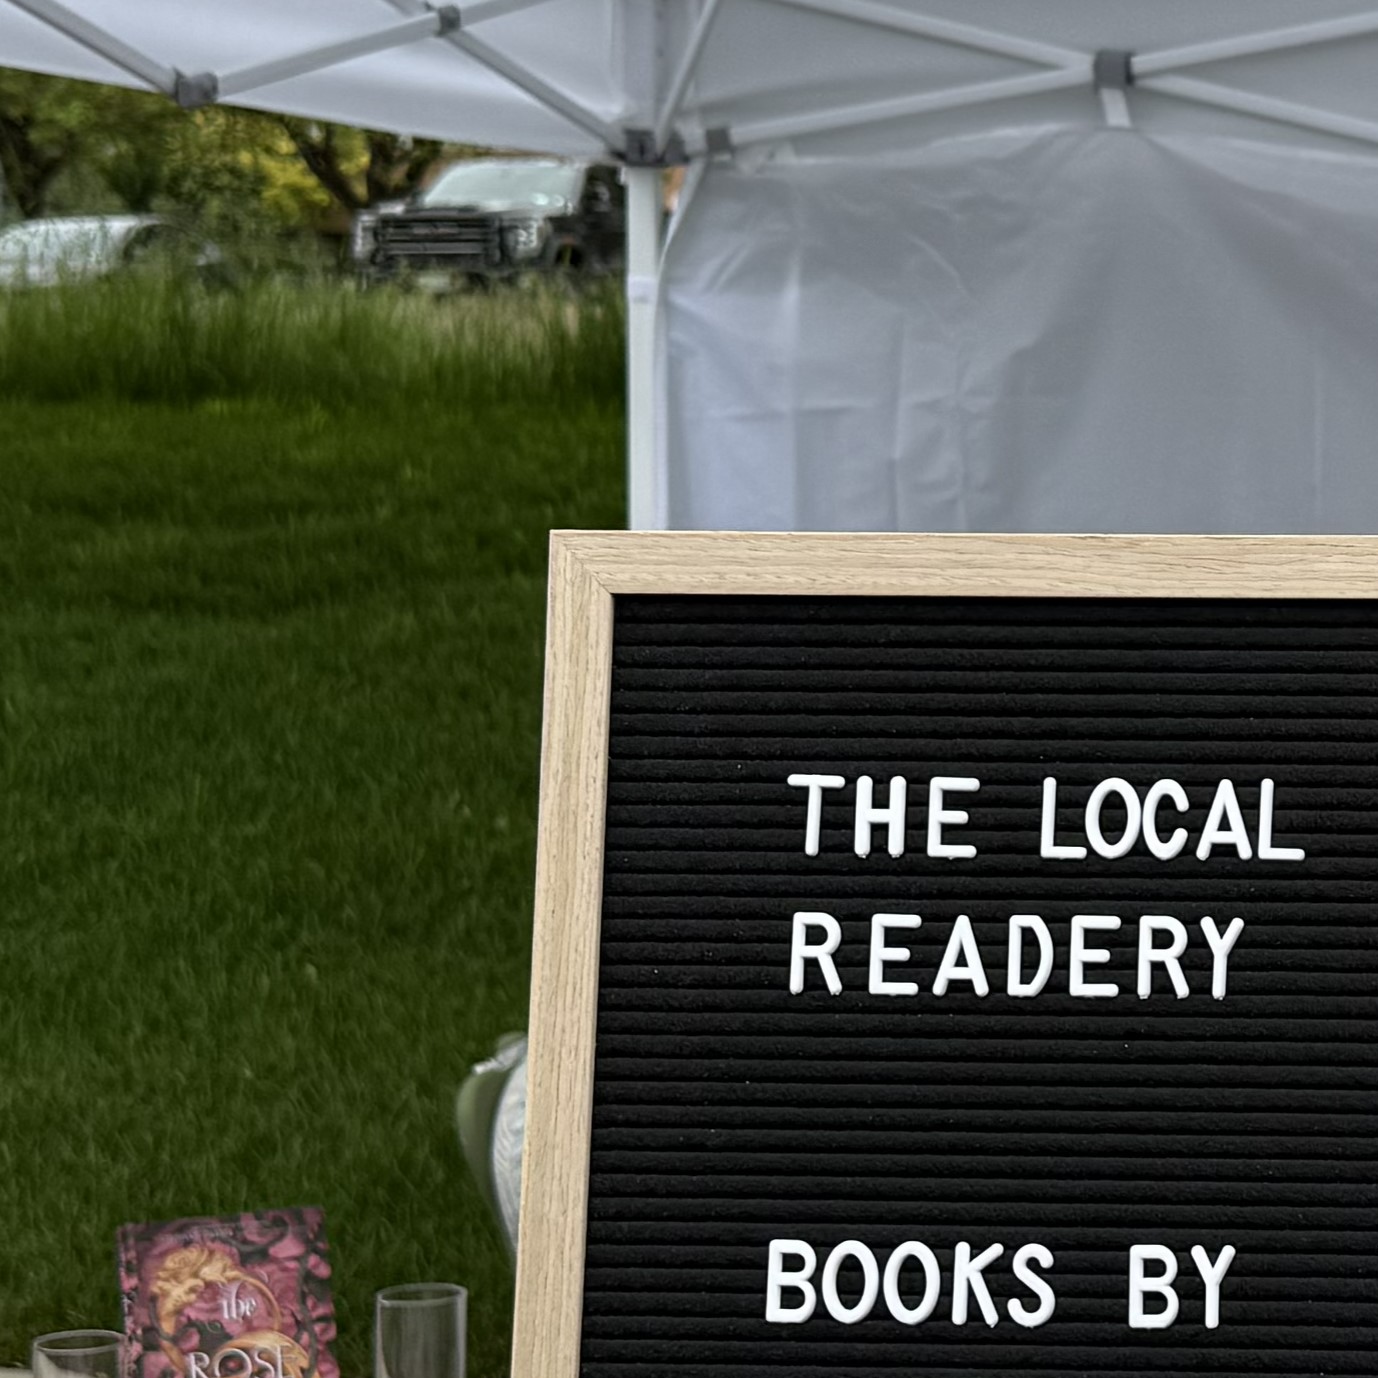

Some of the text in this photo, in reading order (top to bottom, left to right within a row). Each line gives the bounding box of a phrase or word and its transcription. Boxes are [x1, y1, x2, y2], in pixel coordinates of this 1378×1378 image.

[786, 773, 1306, 861] THE LOCAL
[789, 911, 1246, 1001] READERY
[765, 1238, 1237, 1329] BOOKS BY
